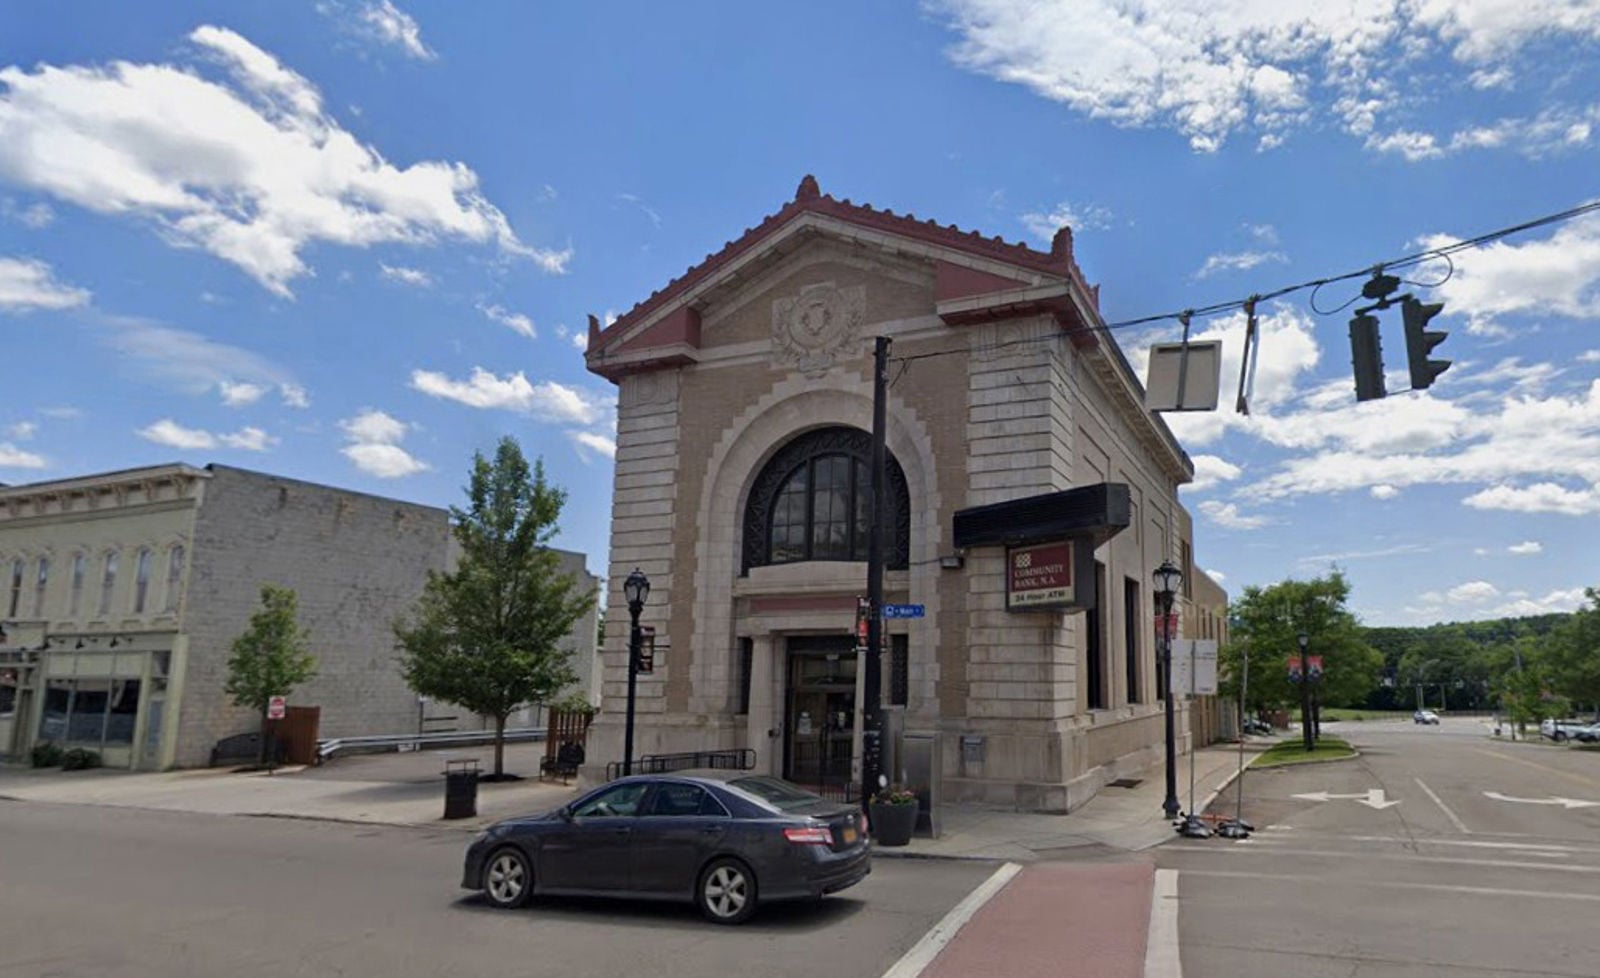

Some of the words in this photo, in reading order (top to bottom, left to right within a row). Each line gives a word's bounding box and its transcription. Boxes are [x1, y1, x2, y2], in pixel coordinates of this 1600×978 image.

[1014, 564, 1064, 578] COMMUNITY
[1015, 594, 1025, 602] 24
[1047, 590, 1066, 598] ATM
